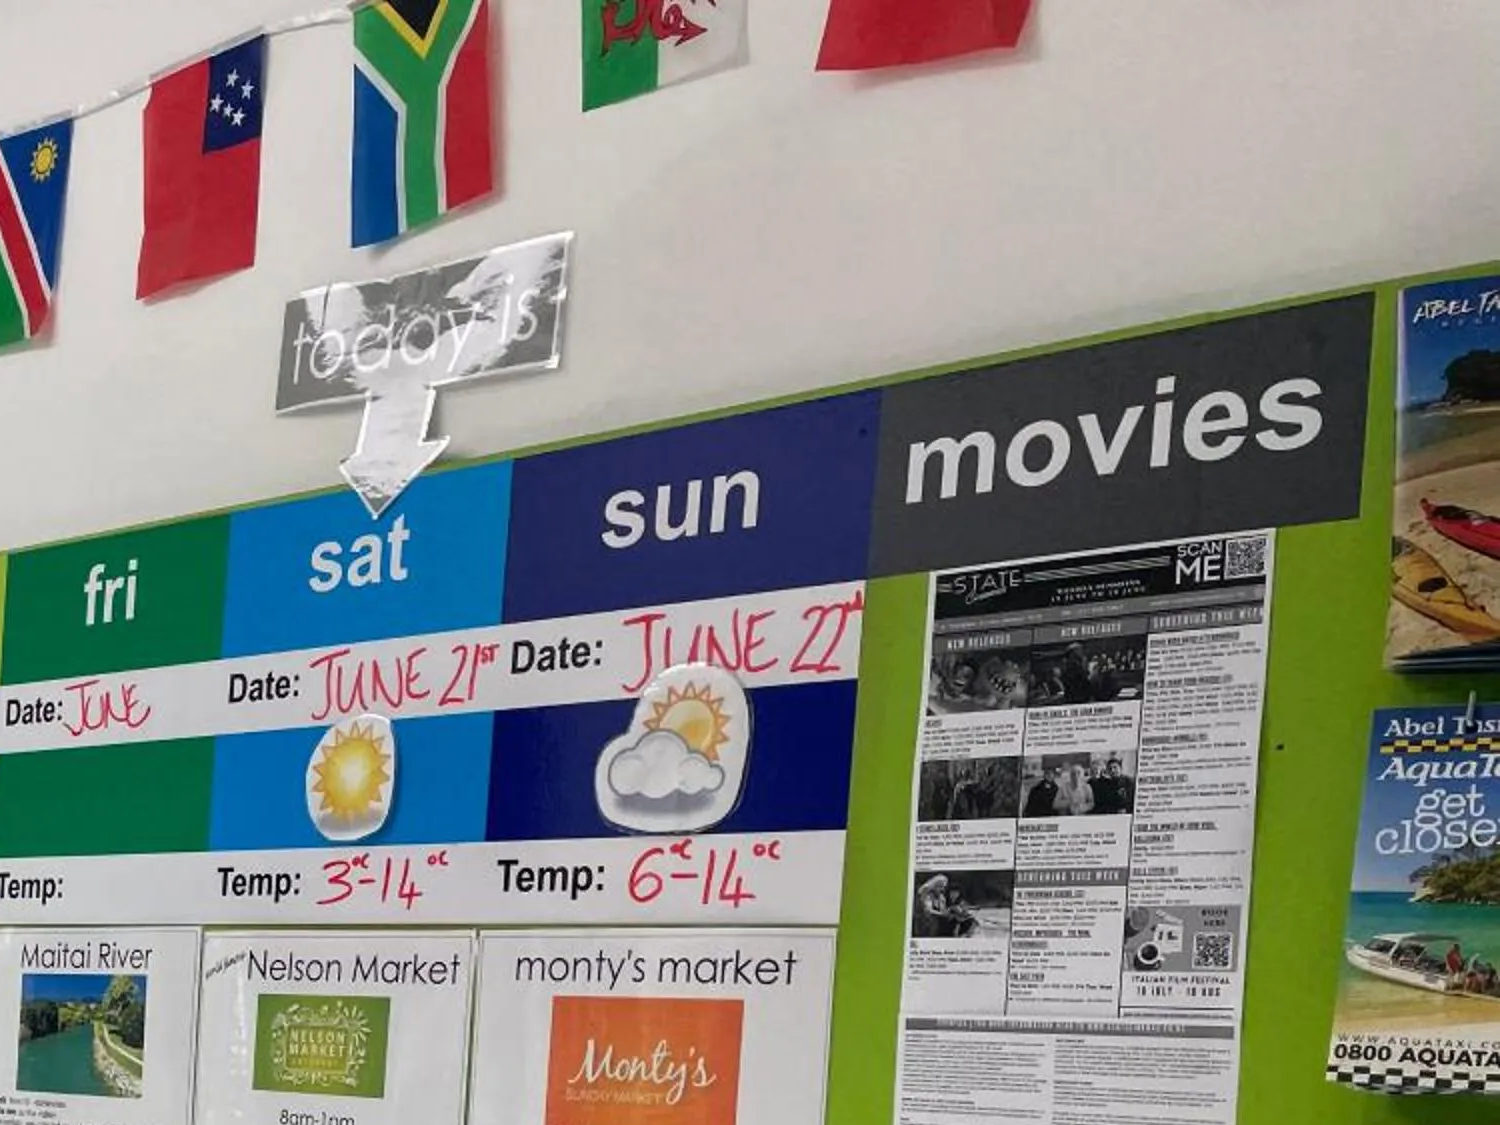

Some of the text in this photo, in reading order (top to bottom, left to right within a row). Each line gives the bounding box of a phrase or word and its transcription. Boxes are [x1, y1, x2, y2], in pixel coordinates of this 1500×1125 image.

[294, 274, 539, 385] today is
[905, 375, 1323, 505] movies
[601, 467, 760, 550] sun
[308, 513, 410, 593] sat
[1175, 555, 1221, 585] ME
[1178, 542, 1222, 558] SCAN
[84, 559, 139, 626] fri
[511, 637, 602, 674] Date:
[623, 608, 778, 692] JUNE
[228, 673, 299, 703] Date:
[311, 649, 431, 720] JUNE
[5, 680, 151, 736] Date: JUNE
[1414, 783, 1485, 827] get
[217, 867, 300, 897] Temp:
[498, 859, 604, 900] Temp:
[21, 942, 153, 970] Maitai River
[246, 950, 461, 985] Nelson Market
[515, 949, 798, 990] monty's market
[289, 1030, 347, 1044] NELSON
[289, 1044, 347, 1058] MARKET
[567, 1038, 716, 1106] Monty's
